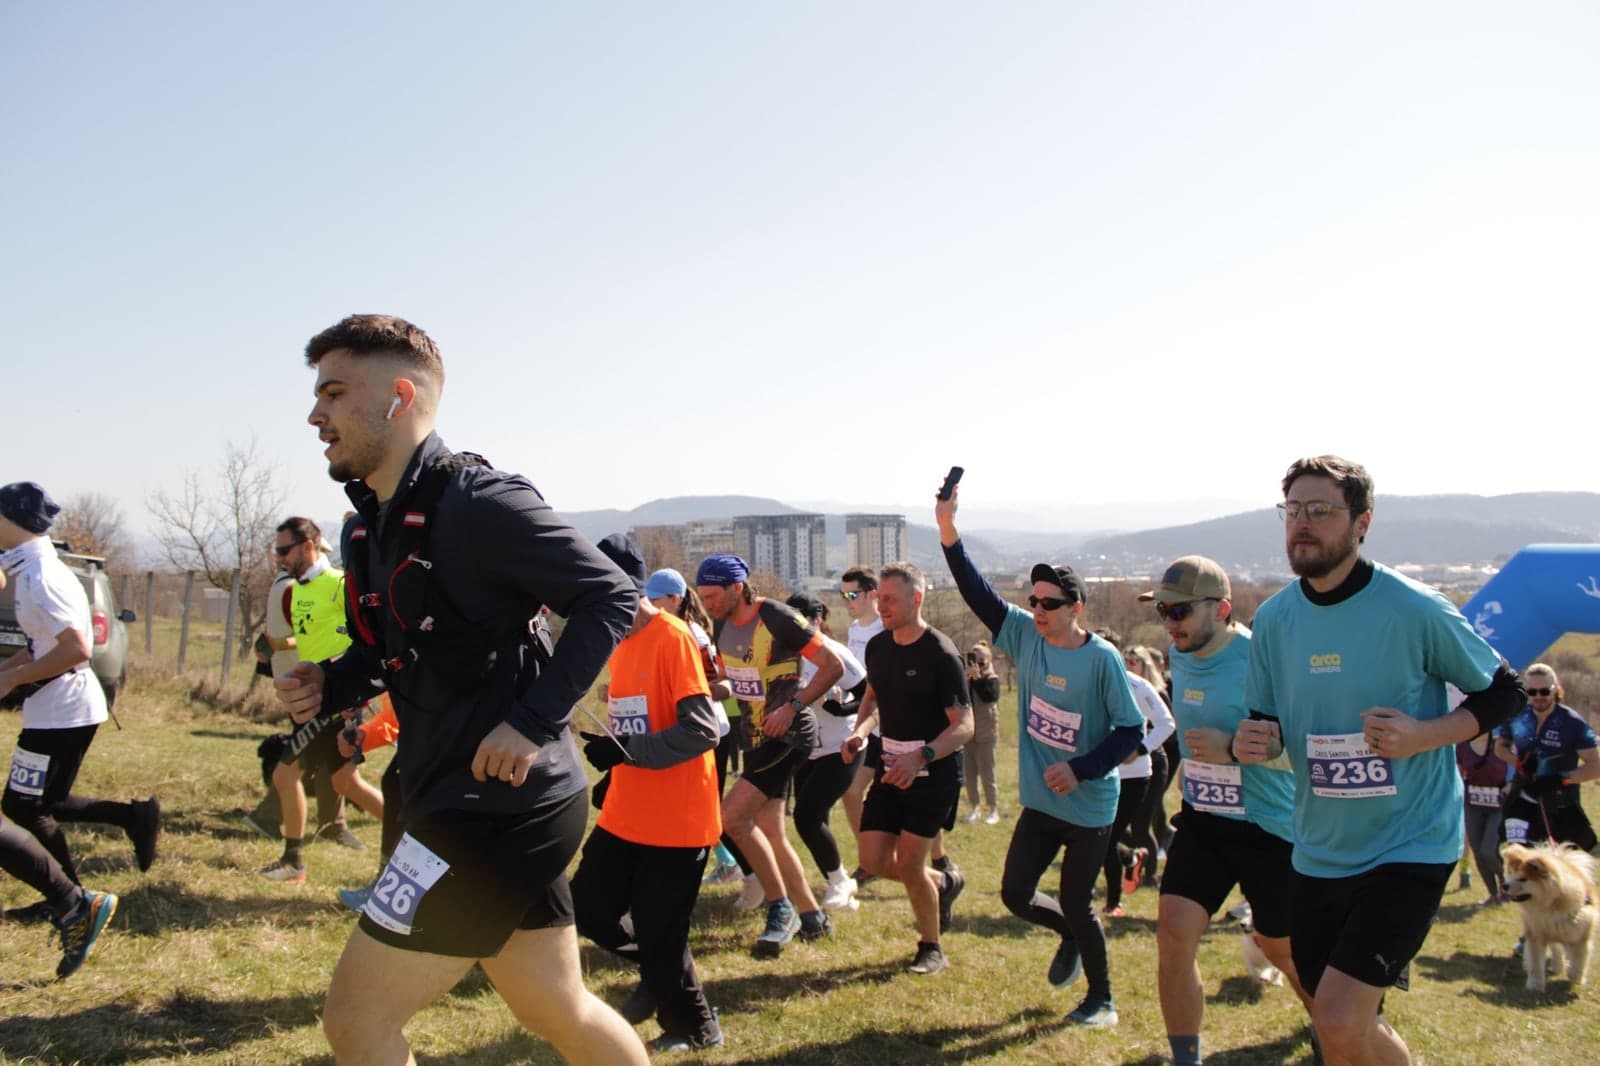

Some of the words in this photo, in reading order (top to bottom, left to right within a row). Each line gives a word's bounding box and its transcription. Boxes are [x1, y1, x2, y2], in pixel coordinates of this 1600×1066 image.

[734, 681, 760, 695] 251
[612, 717, 646, 736] 240
[1039, 719, 1075, 744] 234
[10, 764, 40, 786] 201
[1328, 758, 1388, 785] 236
[1196, 783, 1239, 805] 235
[409, 869, 419, 879] KM
[374, 866, 416, 915] 26
